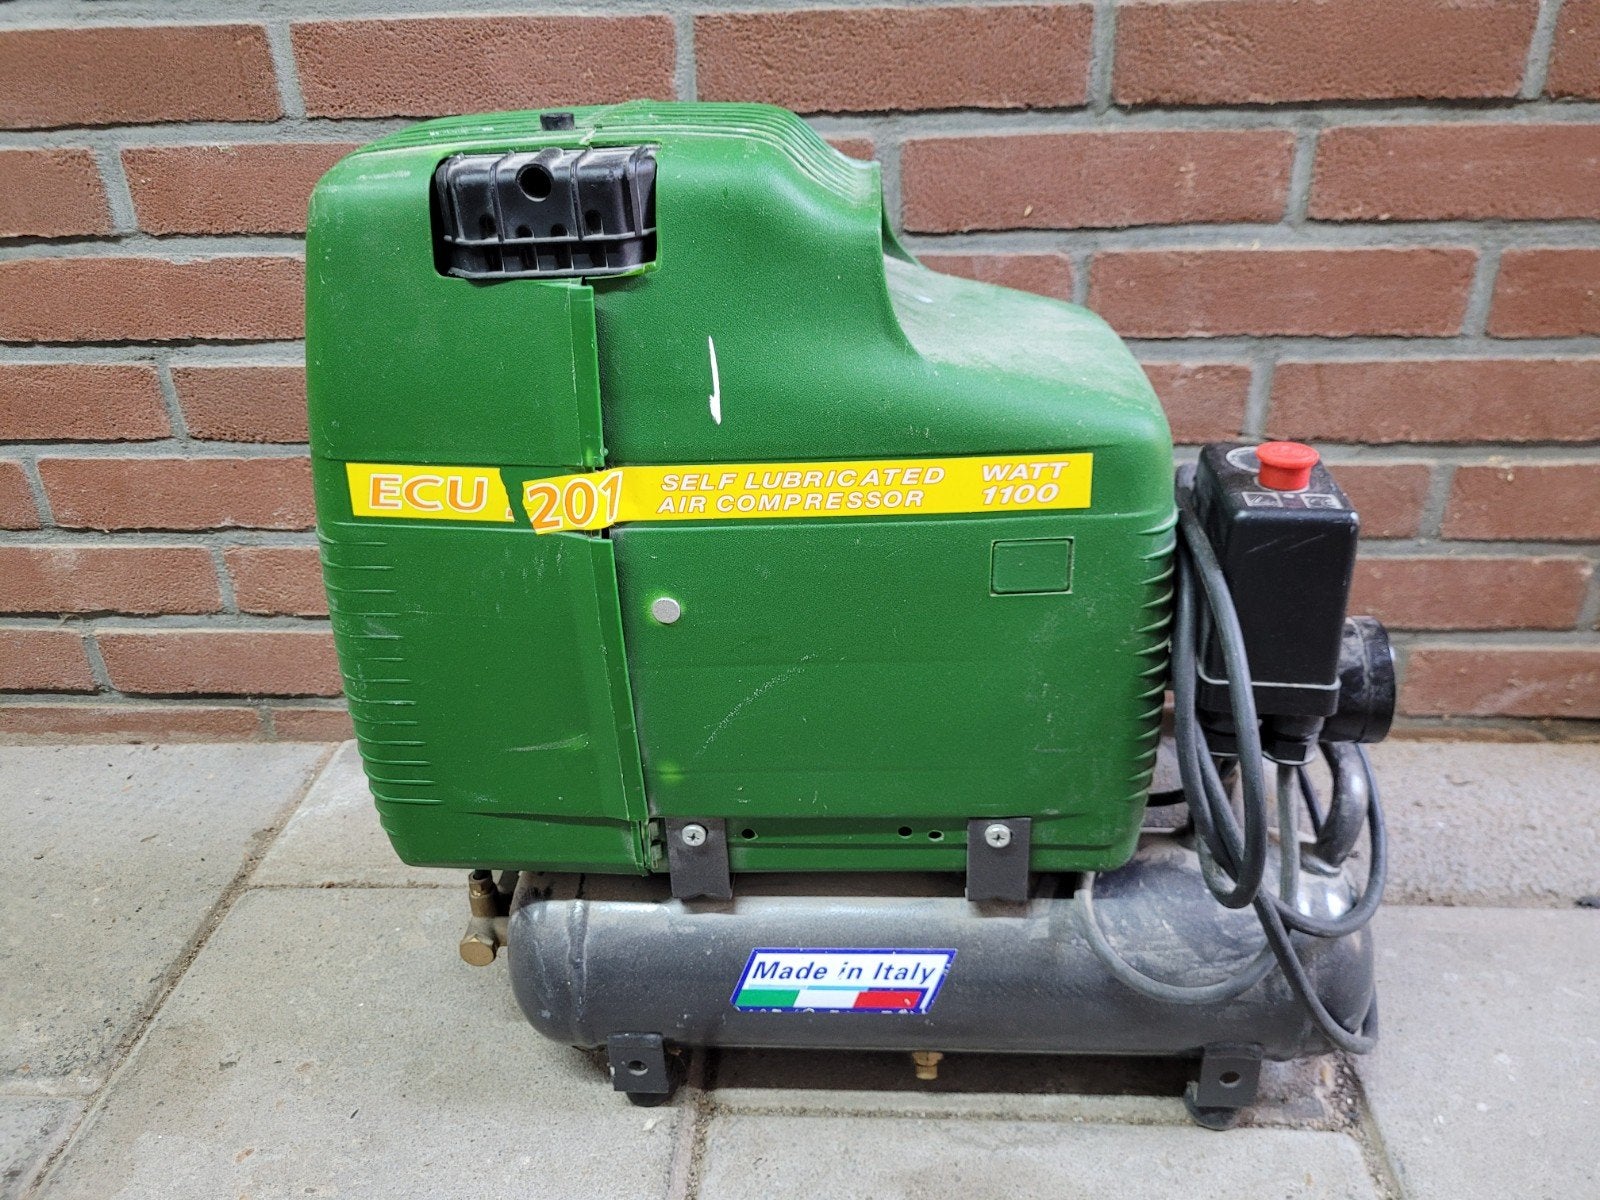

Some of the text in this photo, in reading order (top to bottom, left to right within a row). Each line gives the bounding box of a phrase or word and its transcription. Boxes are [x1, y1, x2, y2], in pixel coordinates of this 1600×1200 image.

[661, 466, 945, 491] SELF LUBRICATED
[982, 461, 1069, 481] WATT
[369, 470, 623, 530] ECU 201
[657, 489, 924, 514] AIR COMPRESSOR
[982, 483, 1060, 505] 1100
[752, 961, 935, 985] Made in Italy
